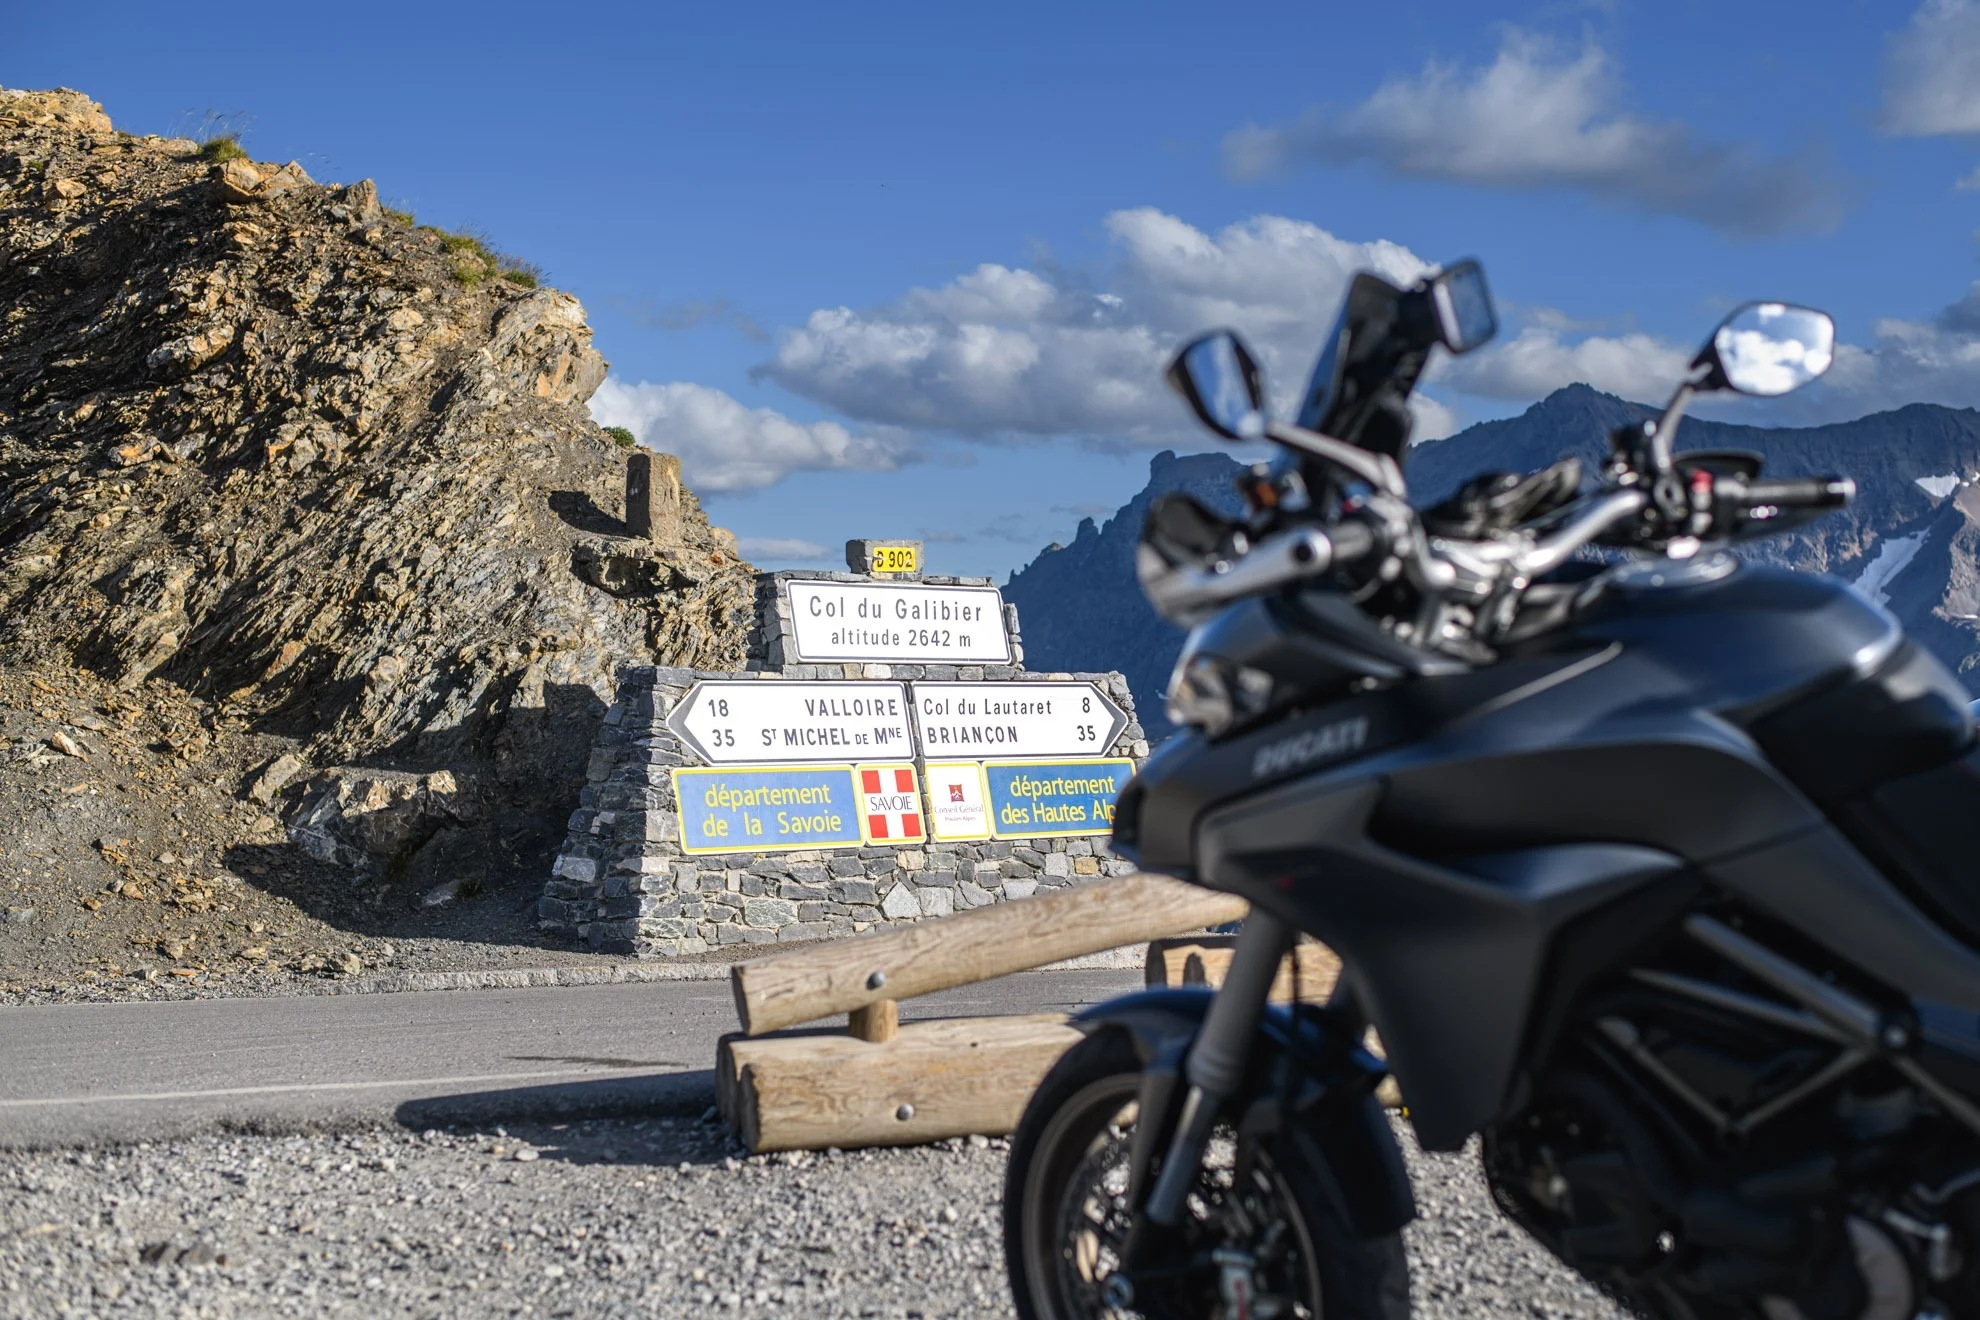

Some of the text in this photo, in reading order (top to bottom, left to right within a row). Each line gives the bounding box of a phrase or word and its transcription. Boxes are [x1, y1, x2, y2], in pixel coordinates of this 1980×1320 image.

[888, 550, 913, 568] 902
[809, 595, 981, 622] Col du Galibier
[831, 628, 971, 648] altitude 2642 m
[708, 699, 898, 718] 18 VALLOIRE
[923, 697, 1091, 716] Col du Lautaret 8
[711, 728, 735, 748] 35
[783, 727, 851, 747] MICHEL
[927, 725, 1097, 745] BRIANÇON 35
[705, 784, 831, 811] département
[1010, 776, 1116, 800] département
[869, 795, 913, 812] SAVOIE
[1001, 798, 1117, 825] des Hautes Alp
[703, 809, 842, 837] de la Savoie
